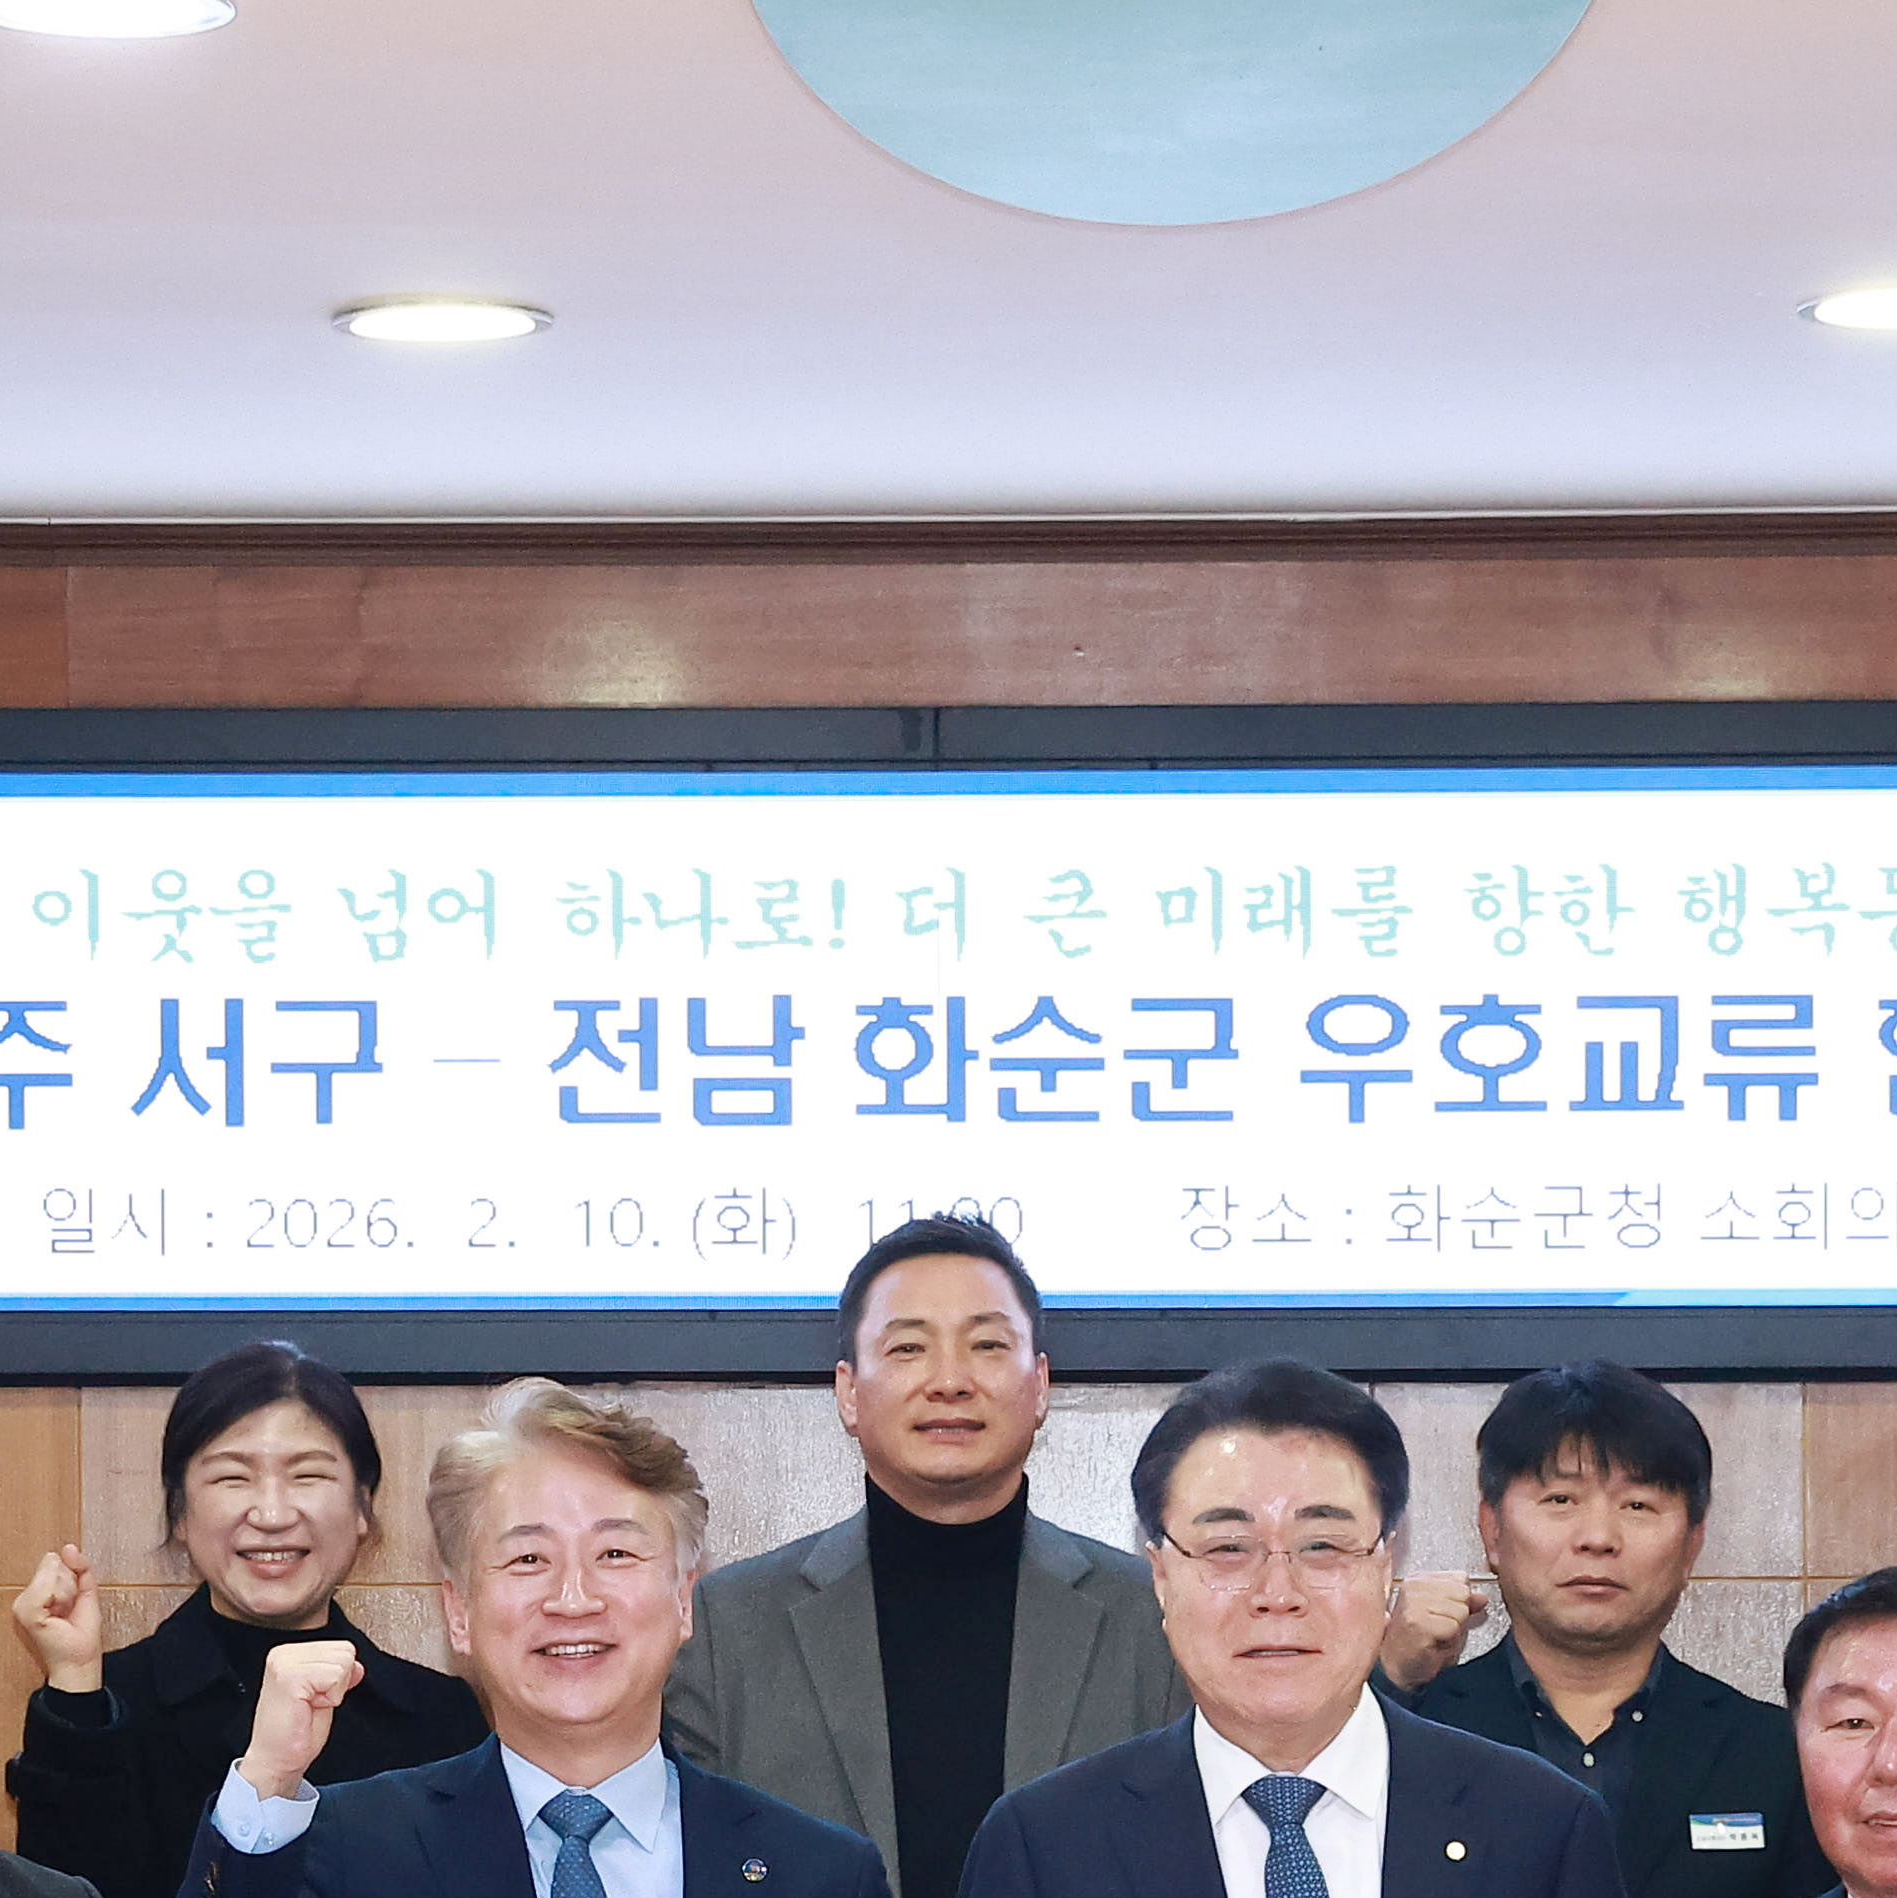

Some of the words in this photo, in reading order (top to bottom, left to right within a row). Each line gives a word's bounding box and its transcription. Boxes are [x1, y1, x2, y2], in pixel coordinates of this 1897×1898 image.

[32, 869, 293, 965] 이웃을
[338, 869, 498, 964] 넘어
[558, 868, 847, 961] 하나로!
[897, 867, 968, 962] 더
[1024, 869, 1109, 960] 큰
[1156, 866, 1415, 960] 미래를
[1466, 864, 1636, 958] 향한
[131, 998, 385, 1129] 서구
[548, 995, 807, 1128] 전남
[854, 995, 1241, 1125] 화순군
[1300, 994, 1821, 1126] 우호교류
[42, 1188, 168, 1258] 일시
[246, 1198, 416, 1250] 2026.
[468, 1198, 518, 1250] 2.
[1181, 1186, 1313, 1253] 장소
[1386, 1184, 1663, 1254] 화순군청
